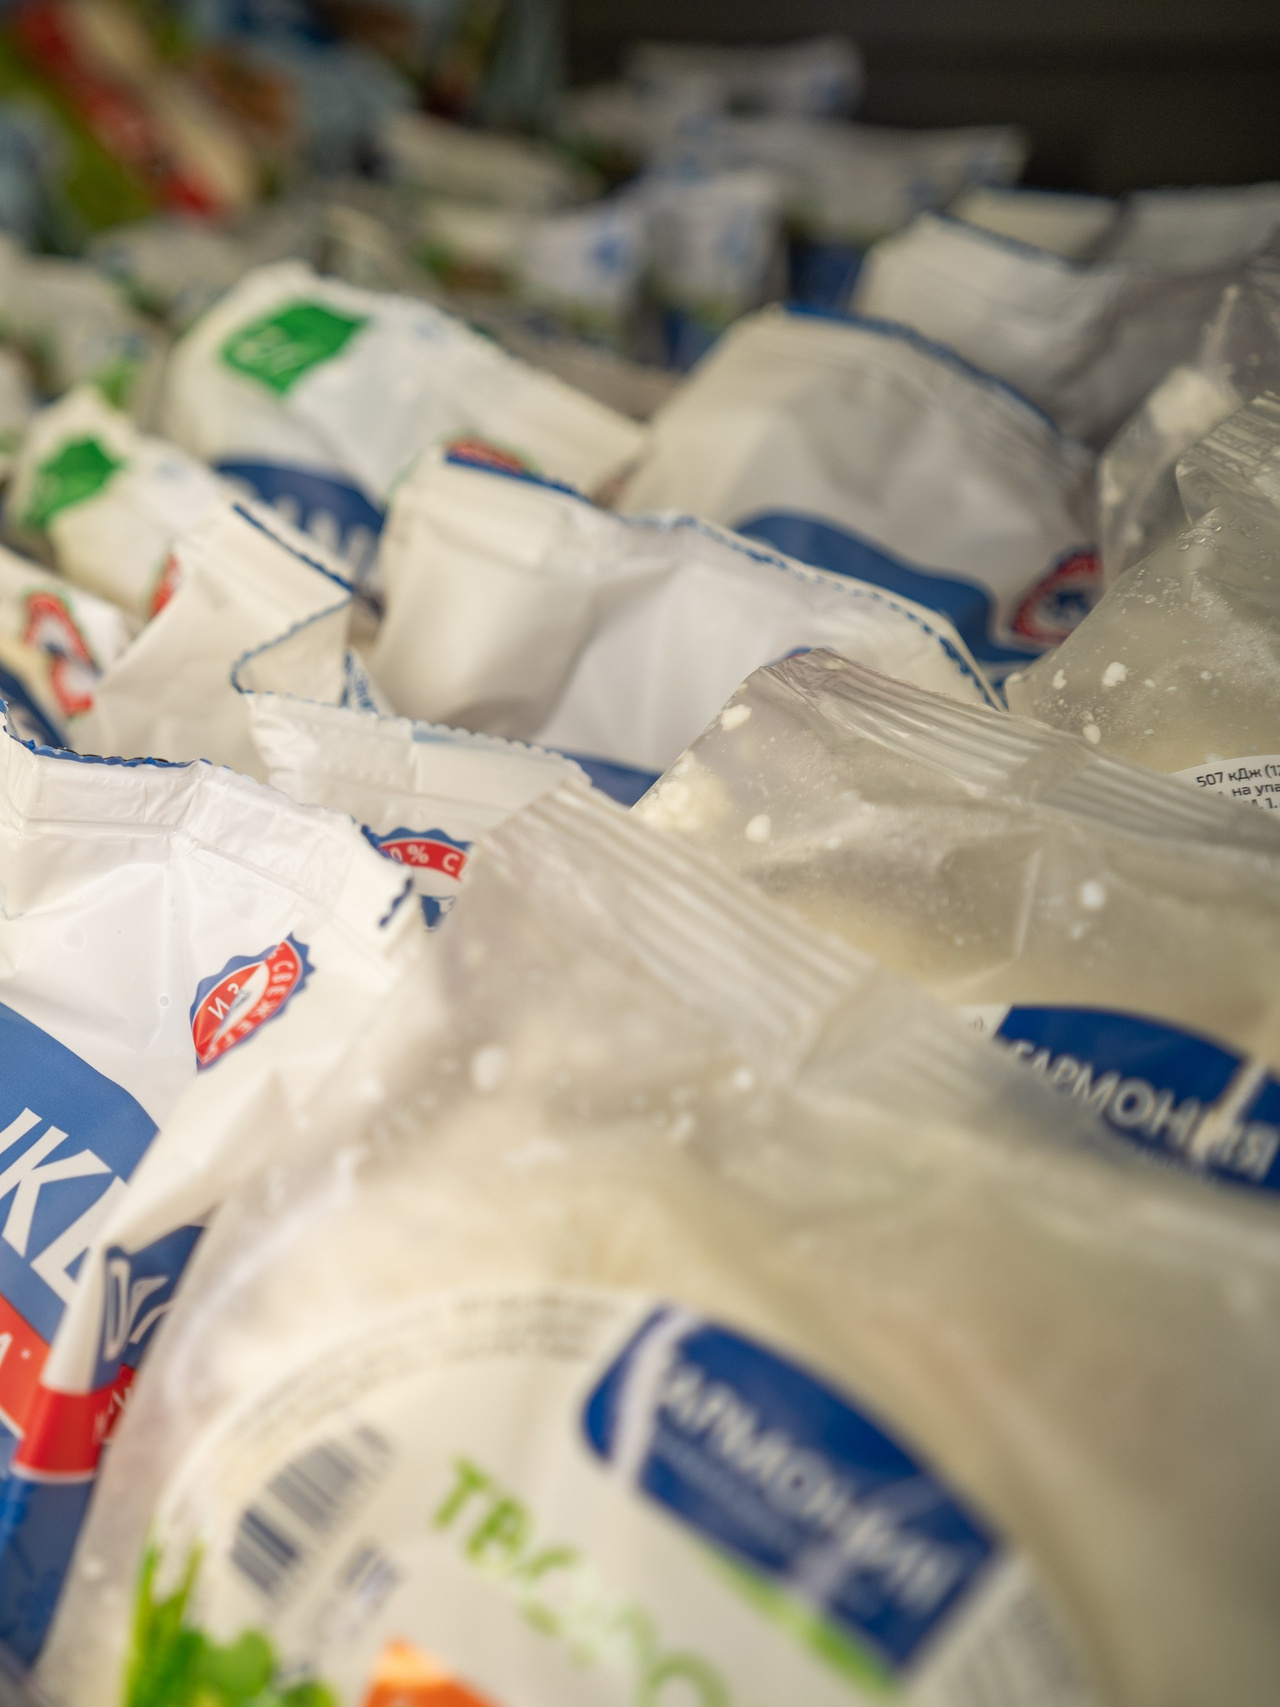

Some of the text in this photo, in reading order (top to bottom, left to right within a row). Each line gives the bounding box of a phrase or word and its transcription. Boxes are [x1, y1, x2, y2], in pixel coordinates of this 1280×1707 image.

[1196, 771, 1223, 788] 507
[1228, 767, 1262, 781] кДж
[1231, 786, 1251, 797] на
